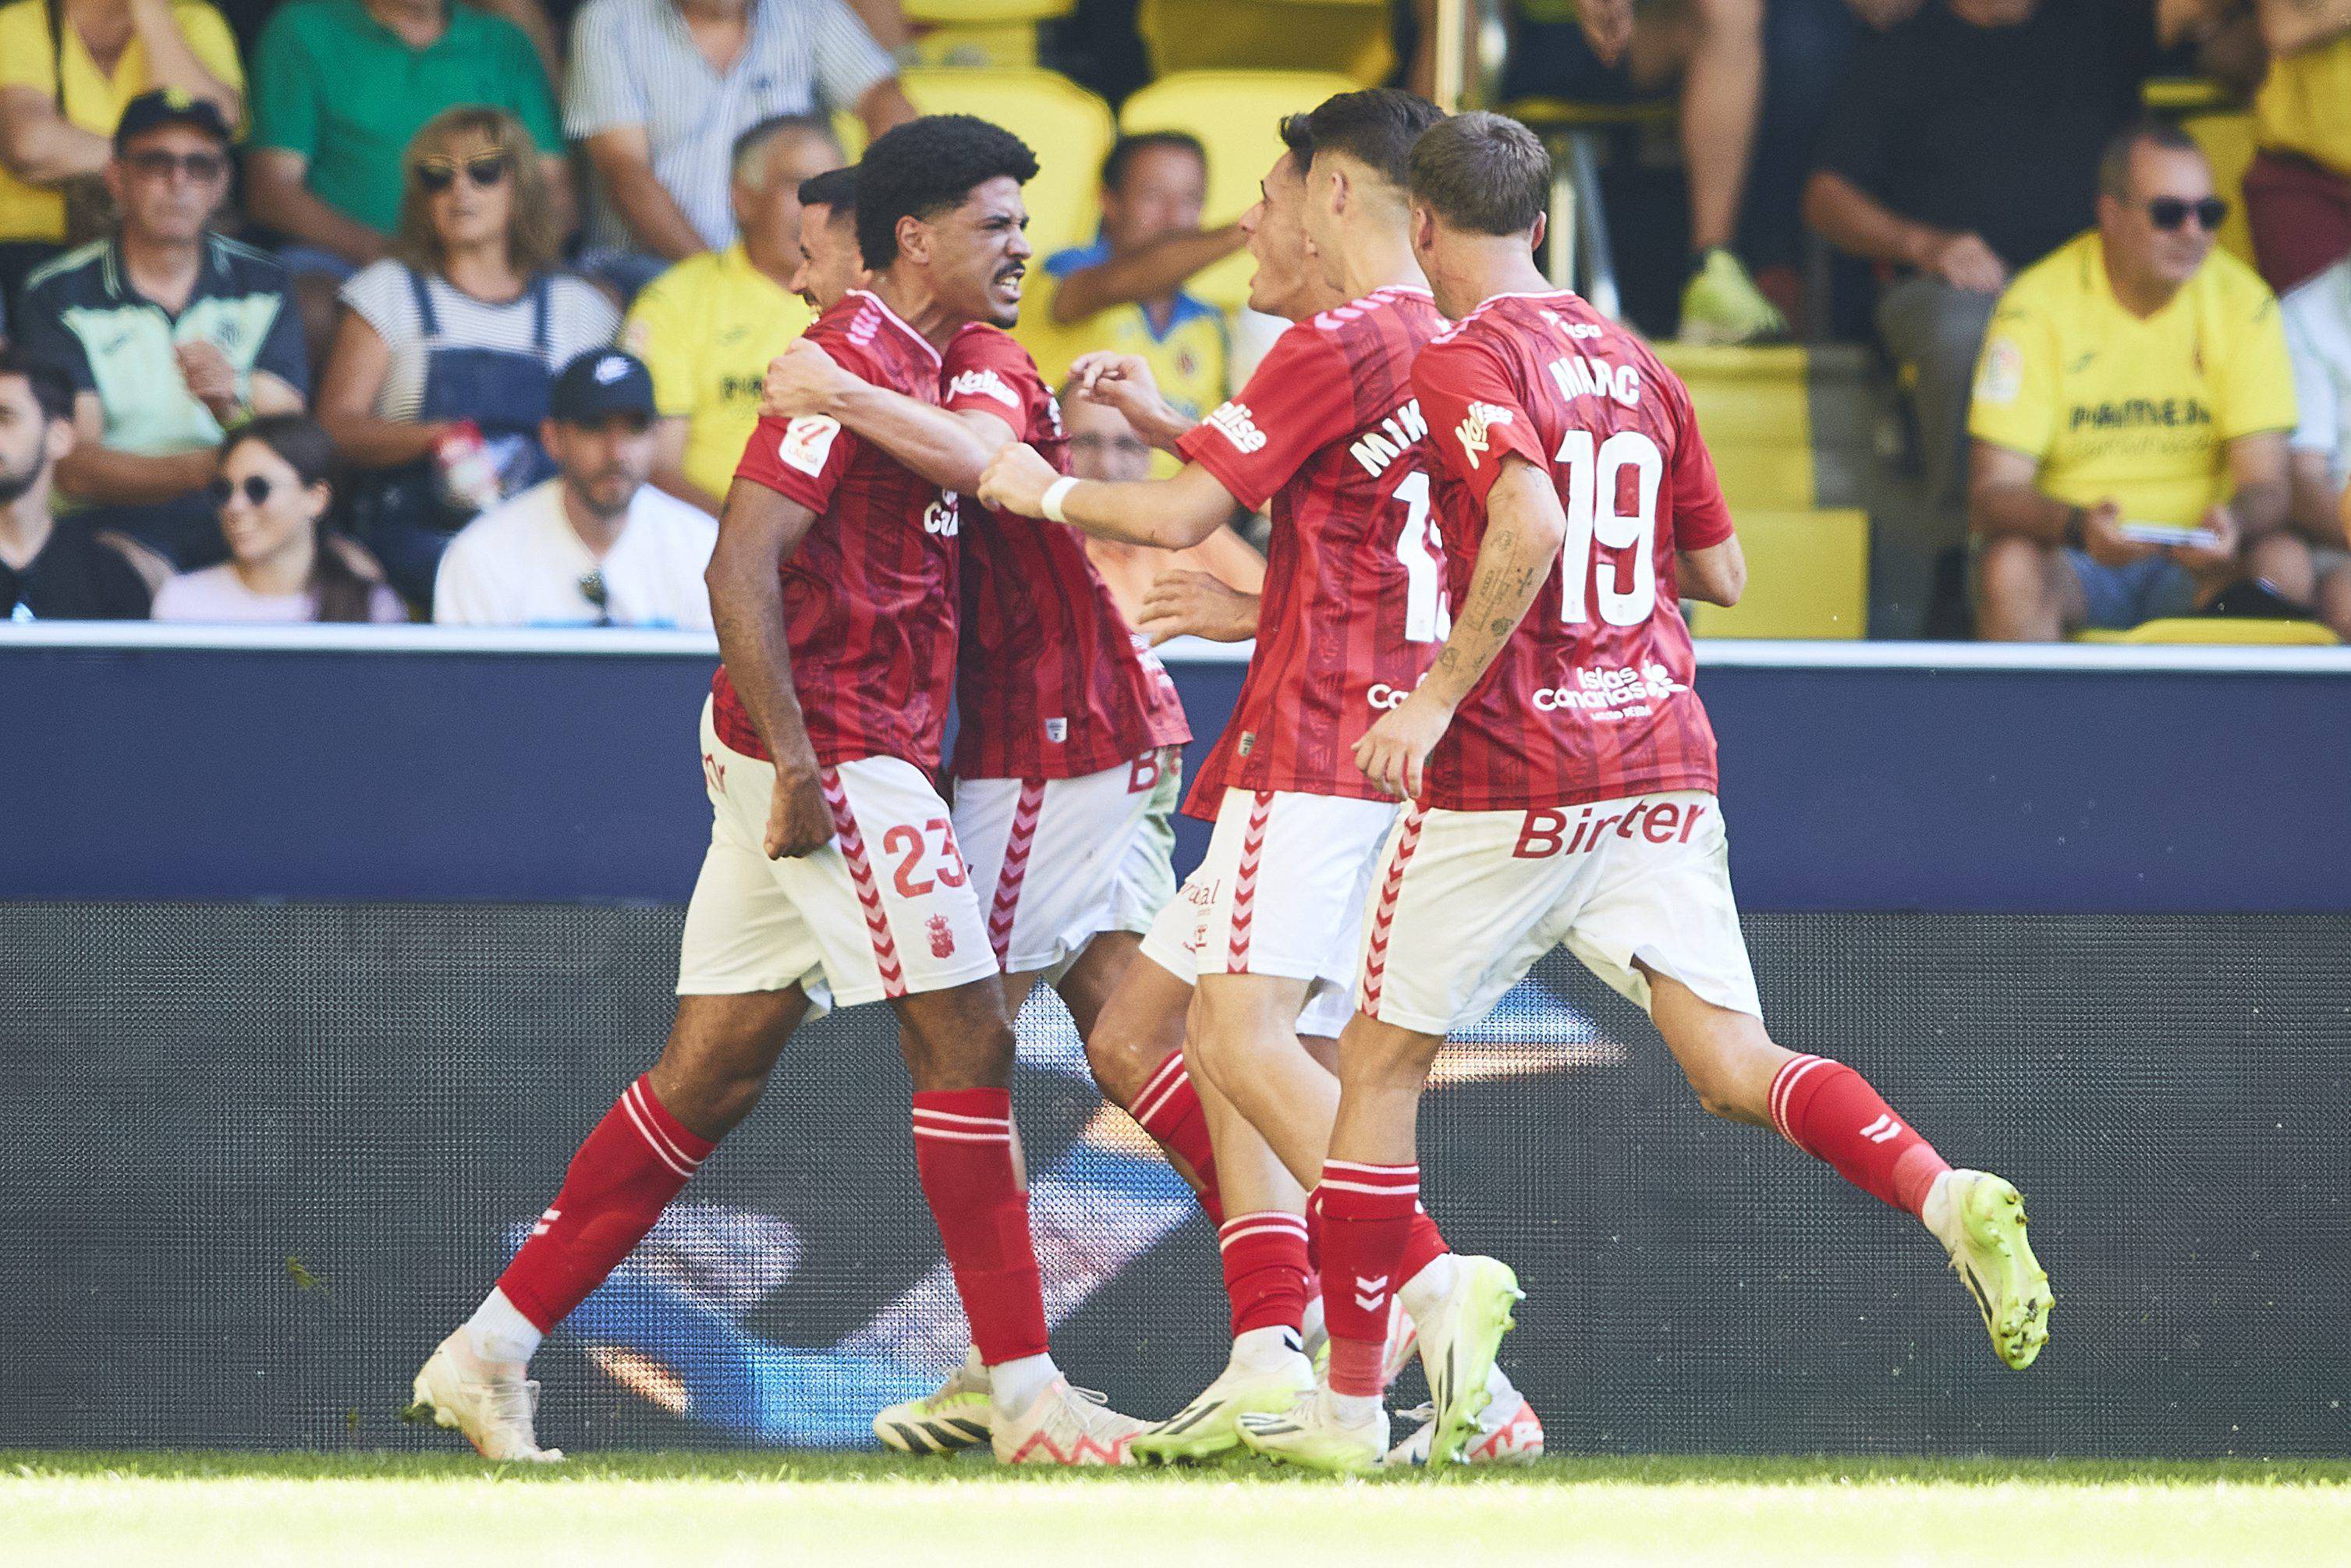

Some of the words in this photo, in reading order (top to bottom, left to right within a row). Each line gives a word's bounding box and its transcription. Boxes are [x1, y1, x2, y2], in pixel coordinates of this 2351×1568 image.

[1548, 356, 1640, 403] MARC
[1349, 399, 1428, 478] MIK
[1392, 470, 1452, 643] 1
[1554, 428, 1663, 626] 19
[1532, 681, 1647, 711] Canarias
[1576, 666, 1638, 689] Islas
[883, 818, 966, 898] 23
